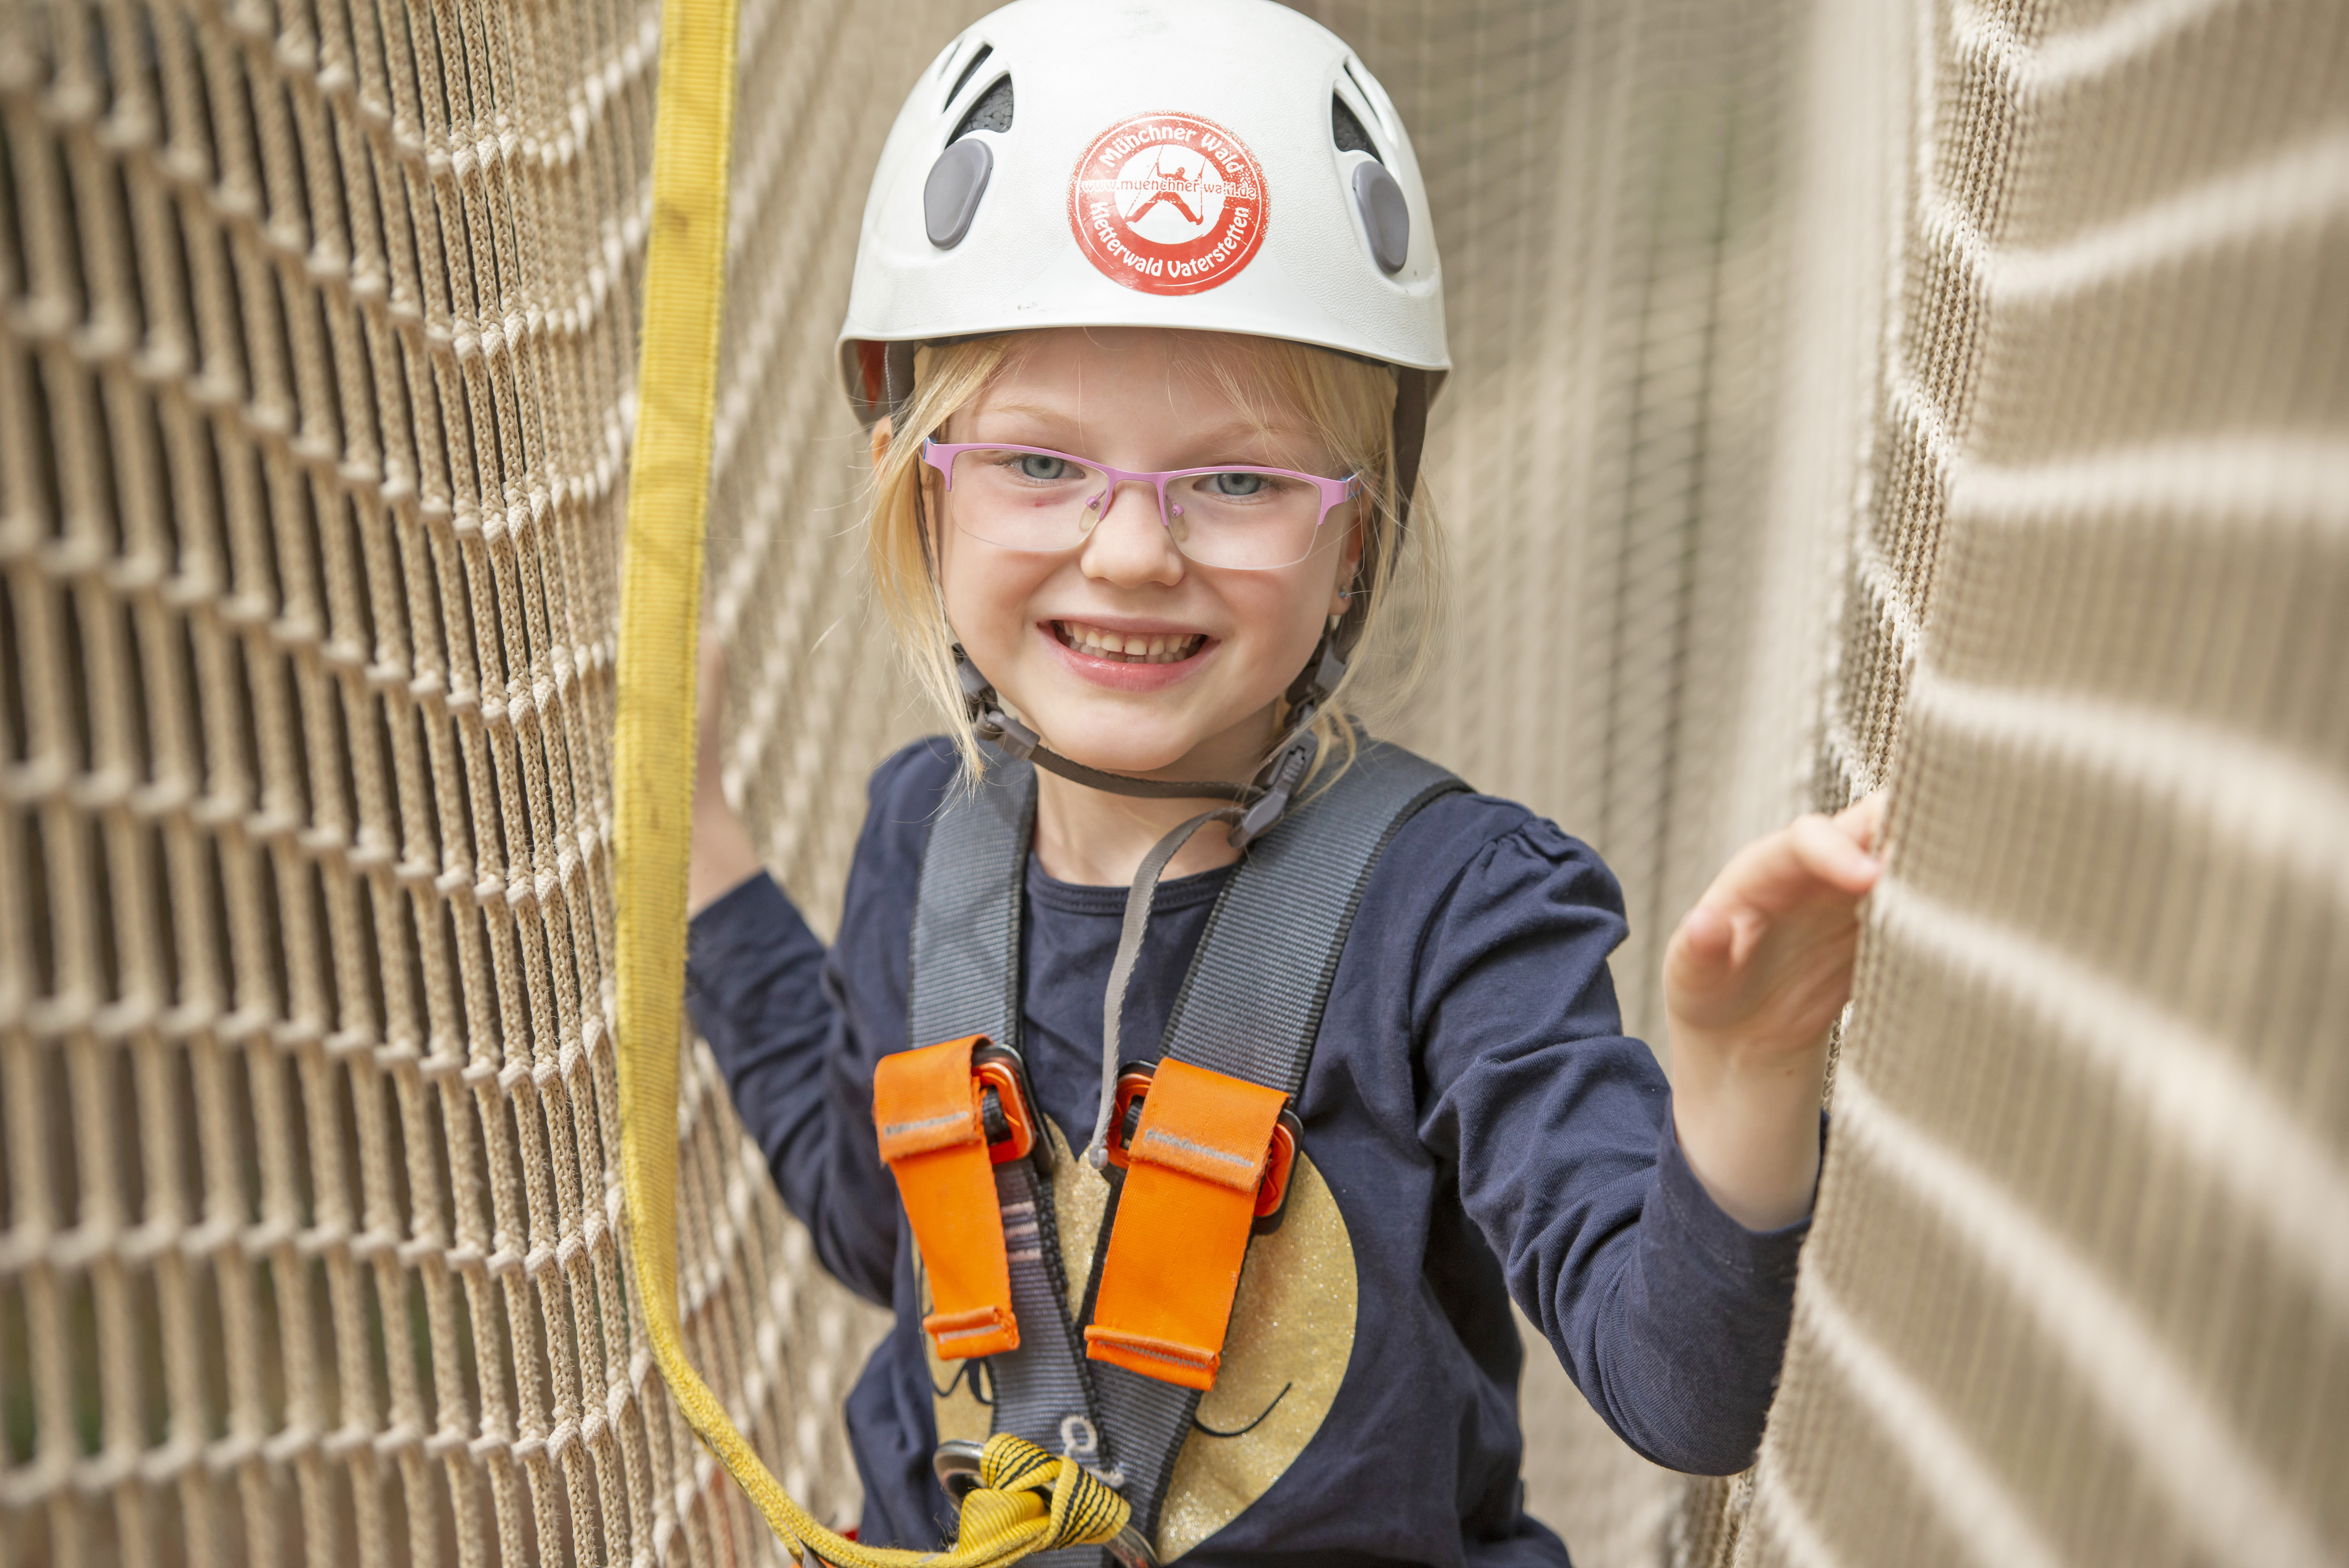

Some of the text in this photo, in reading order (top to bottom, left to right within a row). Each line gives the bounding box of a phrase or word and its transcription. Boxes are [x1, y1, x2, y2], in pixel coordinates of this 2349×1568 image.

[1098, 124, 1245, 173] Münchner Wald
[1090, 202, 1249, 278] Kletterwald Vaterstetten
